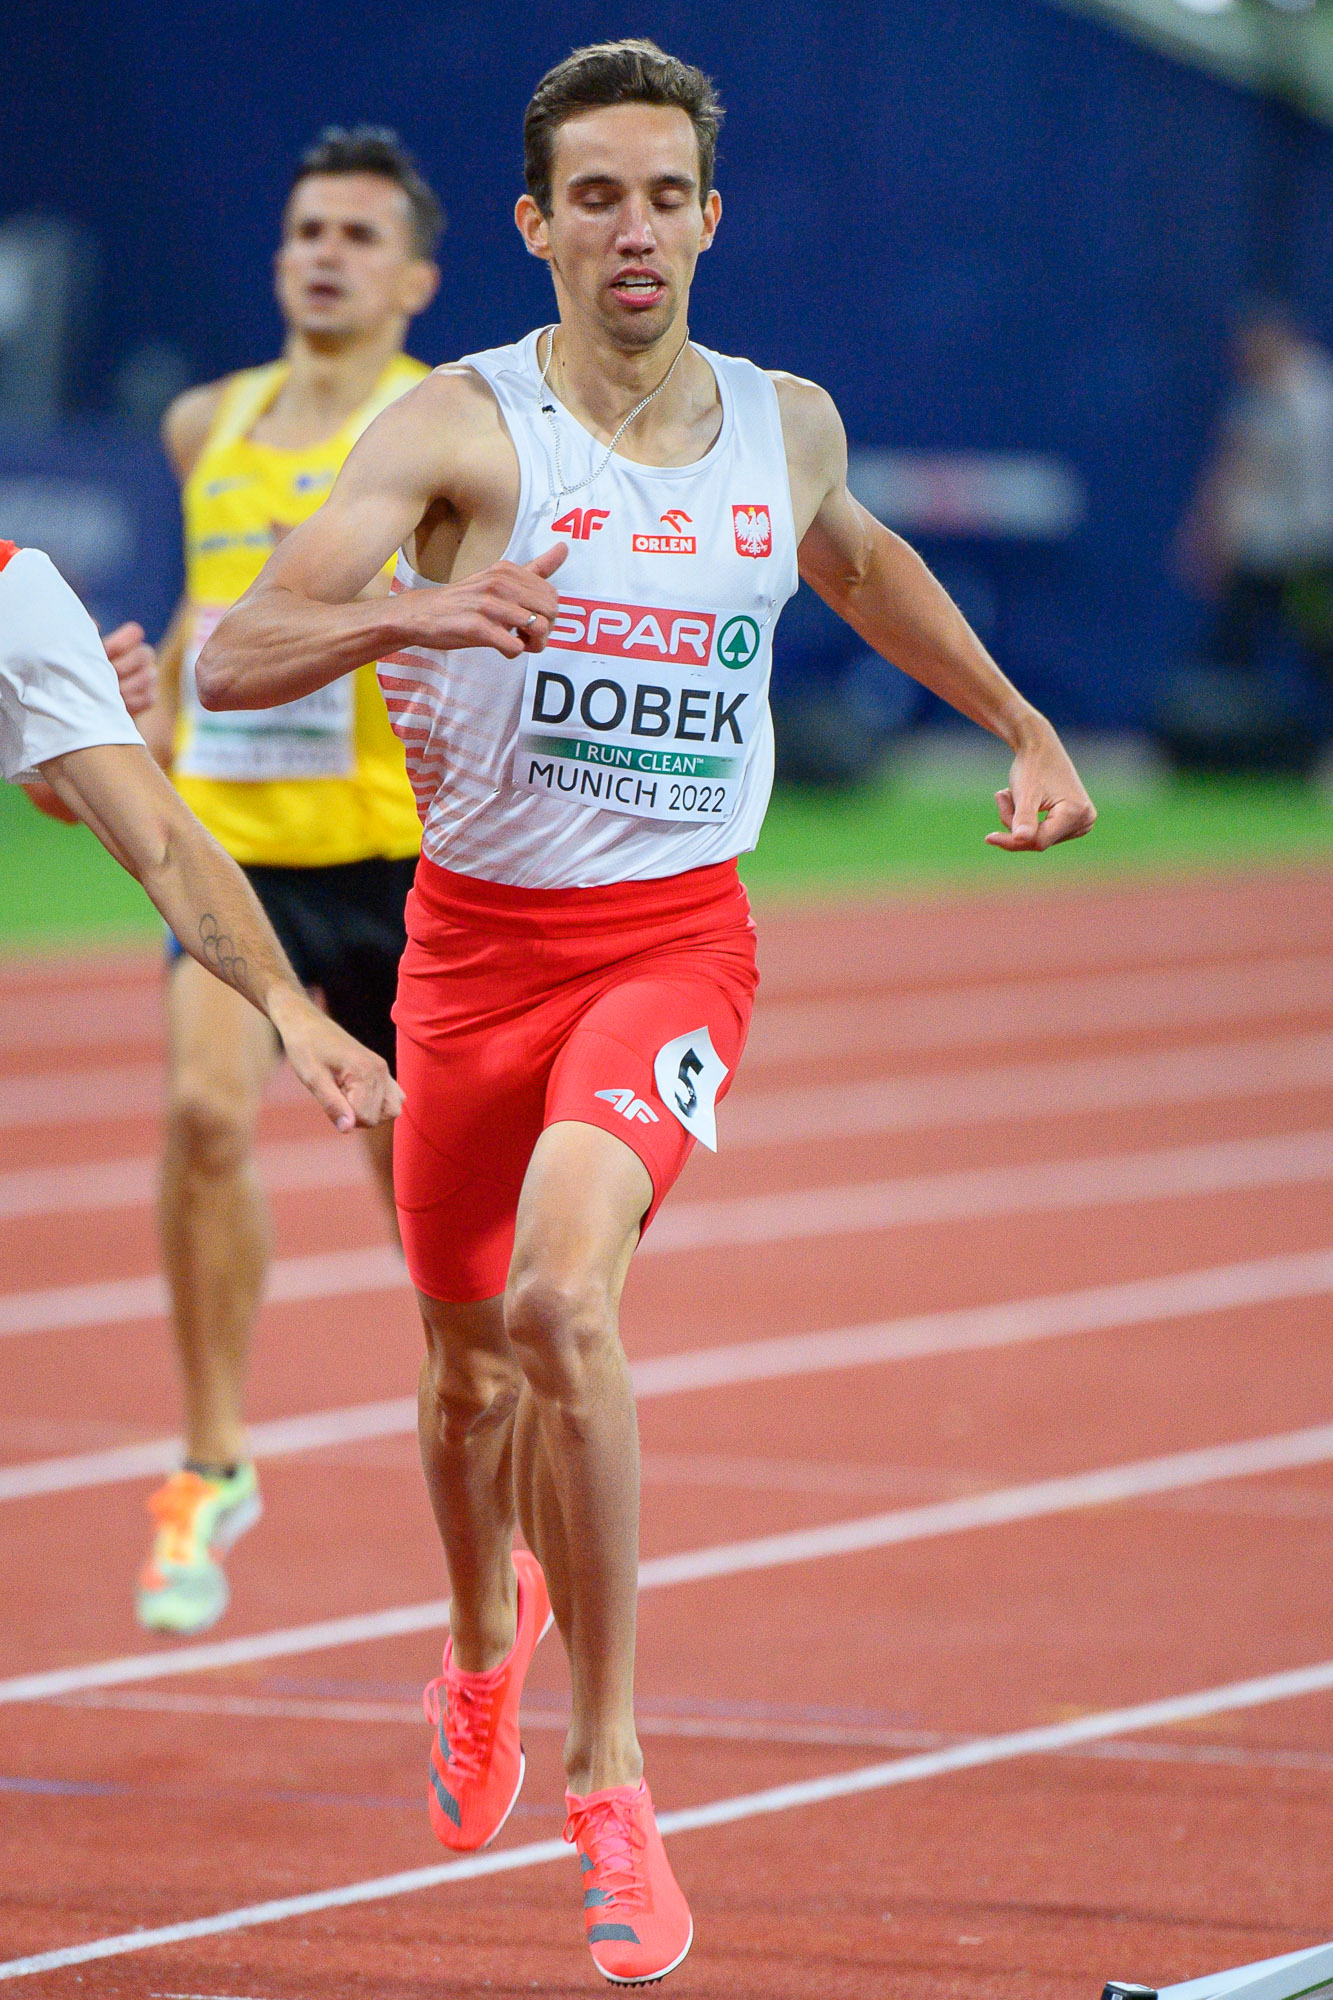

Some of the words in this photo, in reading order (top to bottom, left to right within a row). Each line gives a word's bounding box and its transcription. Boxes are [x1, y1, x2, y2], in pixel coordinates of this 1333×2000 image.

[551, 507, 610, 540] 4F
[635, 537, 693, 552] ORLEN
[550, 604, 709, 658] SPAR
[531, 670, 750, 744] DOBEK
[575, 742, 581, 757] I
[587, 744, 632, 766] RUN
[528, 760, 657, 808] MUNICH
[668, 783, 726, 813] 2022
[674, 1047, 704, 1119] 5
[594, 1088, 660, 1124] 4F
